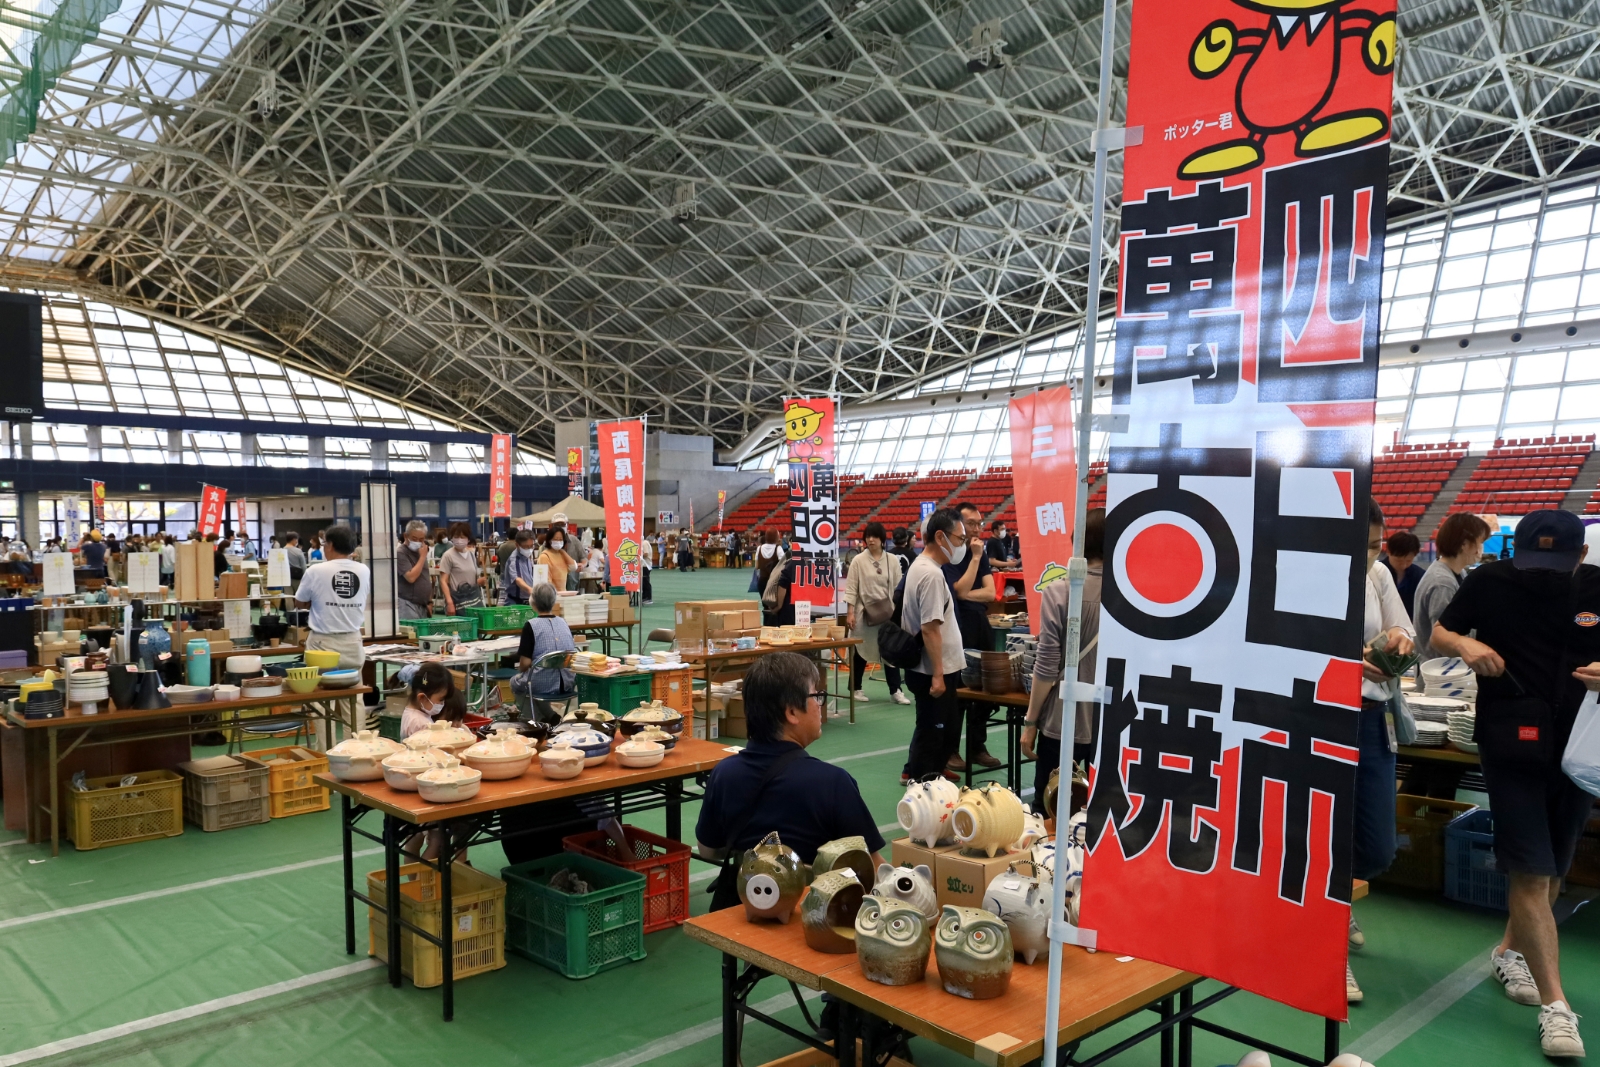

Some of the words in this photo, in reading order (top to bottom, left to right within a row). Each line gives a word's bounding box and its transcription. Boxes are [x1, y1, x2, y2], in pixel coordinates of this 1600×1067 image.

[1164, 112, 1233, 141] ポッター君
[5, 406, 33, 414] SEIKO
[1084, 179, 1252, 875] 萬古焼
[1232, 141, 1389, 906] 四日市
[946, 876, 974, 893] 蚊とり
